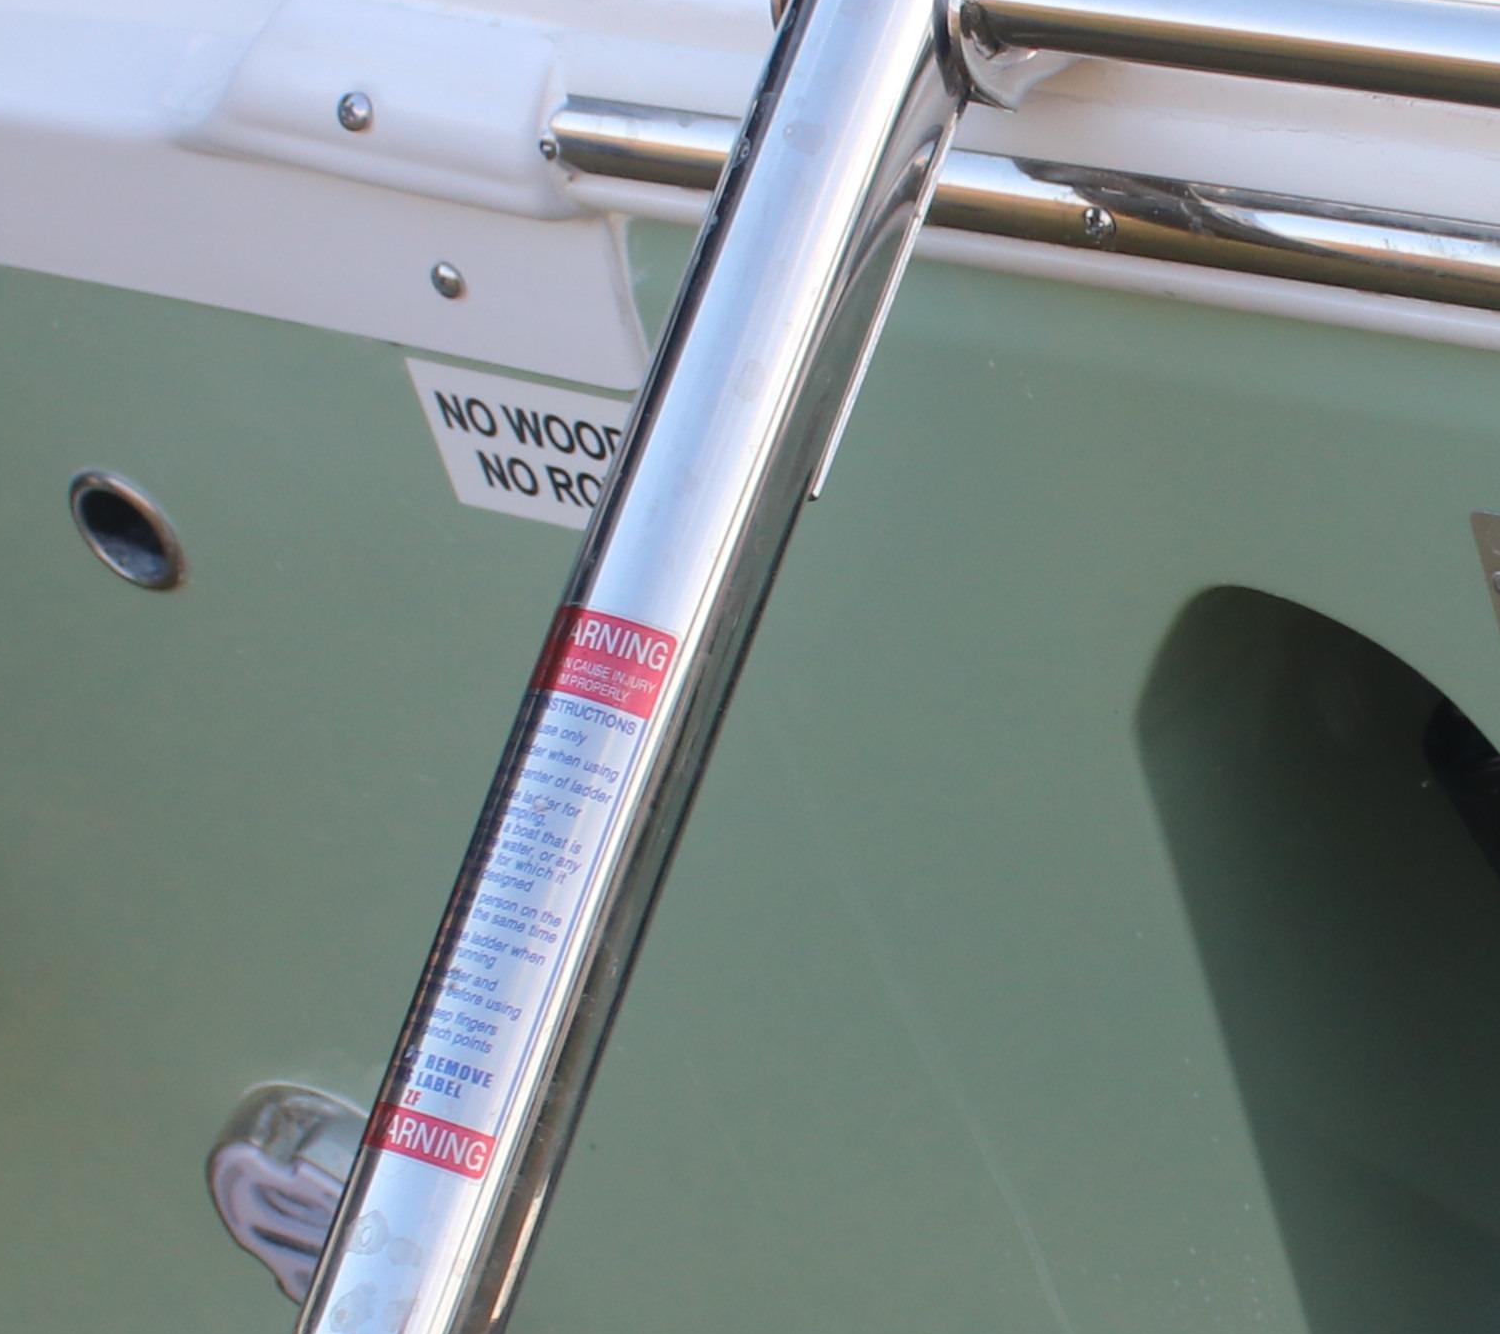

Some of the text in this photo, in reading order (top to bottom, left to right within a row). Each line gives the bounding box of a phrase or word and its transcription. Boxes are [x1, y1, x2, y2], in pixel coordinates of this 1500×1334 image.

[434, 389, 498, 438] NO
[476, 449, 608, 509] NO RO
[557, 673, 631, 703] MPROPERLY
[572, 657, 611, 680] CAUSE
[612, 669, 659, 695] INJURY
[547, 697, 637, 736] STRUCTIONS
[560, 727, 588, 747] only
[548, 747, 581, 768] when
[584, 761, 620, 784] using
[554, 776, 571, 790] of
[570, 779, 614, 805] ladder
[560, 800, 583, 818] for
[512, 823, 540, 841] boat
[541, 831, 569, 850] that
[569, 839, 583, 855] is
[515, 858, 555, 880] which
[555, 871, 568, 885] it
[539, 849, 557, 863] or
[555, 855, 583, 876] any
[477, 892, 563, 927] person on the
[491, 914, 526, 933] same
[528, 923, 558, 944] time
[471, 930, 509, 952] ladder
[510, 945, 546, 967] when
[472, 976, 499, 992] and
[454, 1010, 499, 1036] fingers
[485, 997, 523, 1022] using
[452, 1033, 493, 1054] points
[414, 1071, 463, 1100] LABEL
[424, 1054, 496, 1089] REMOVE
